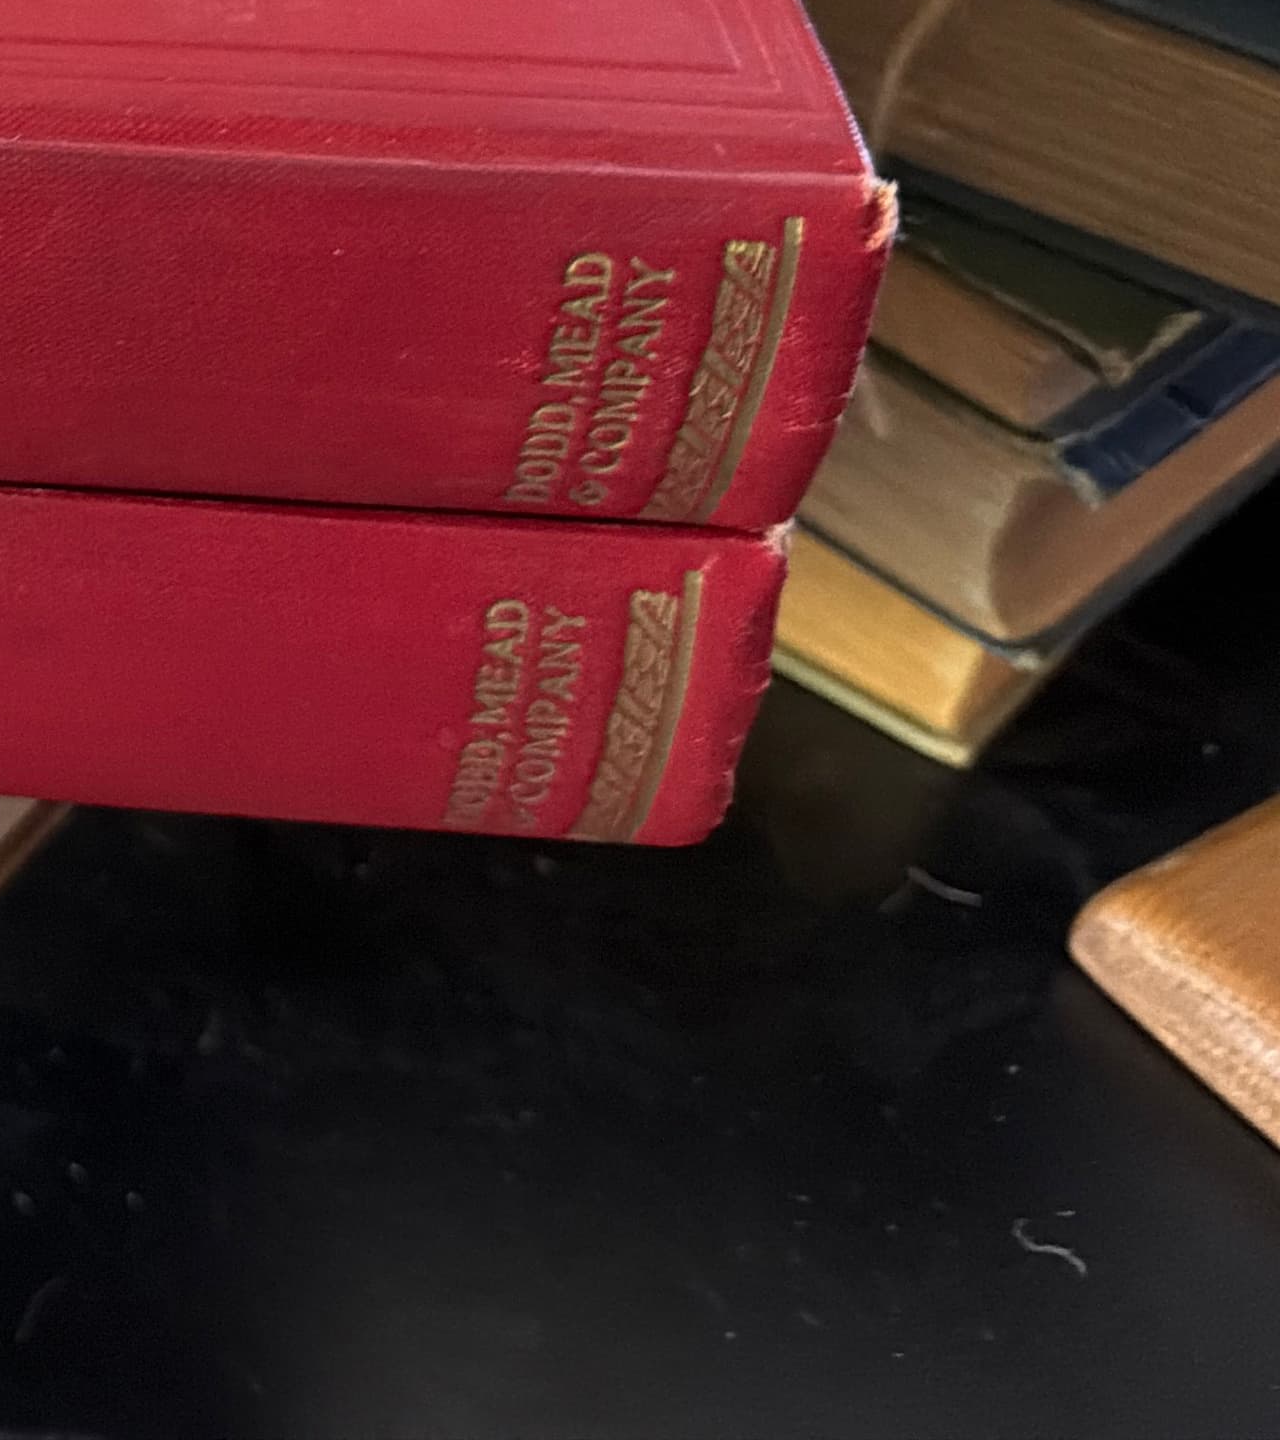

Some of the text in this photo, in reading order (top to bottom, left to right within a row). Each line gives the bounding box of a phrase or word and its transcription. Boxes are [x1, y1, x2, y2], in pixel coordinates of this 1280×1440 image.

[545, 251, 613, 387] MEAD
[580, 256, 676, 474] COMPANY
[471, 598, 529, 726] MEAD
[509, 606, 586, 804] COMPANY
